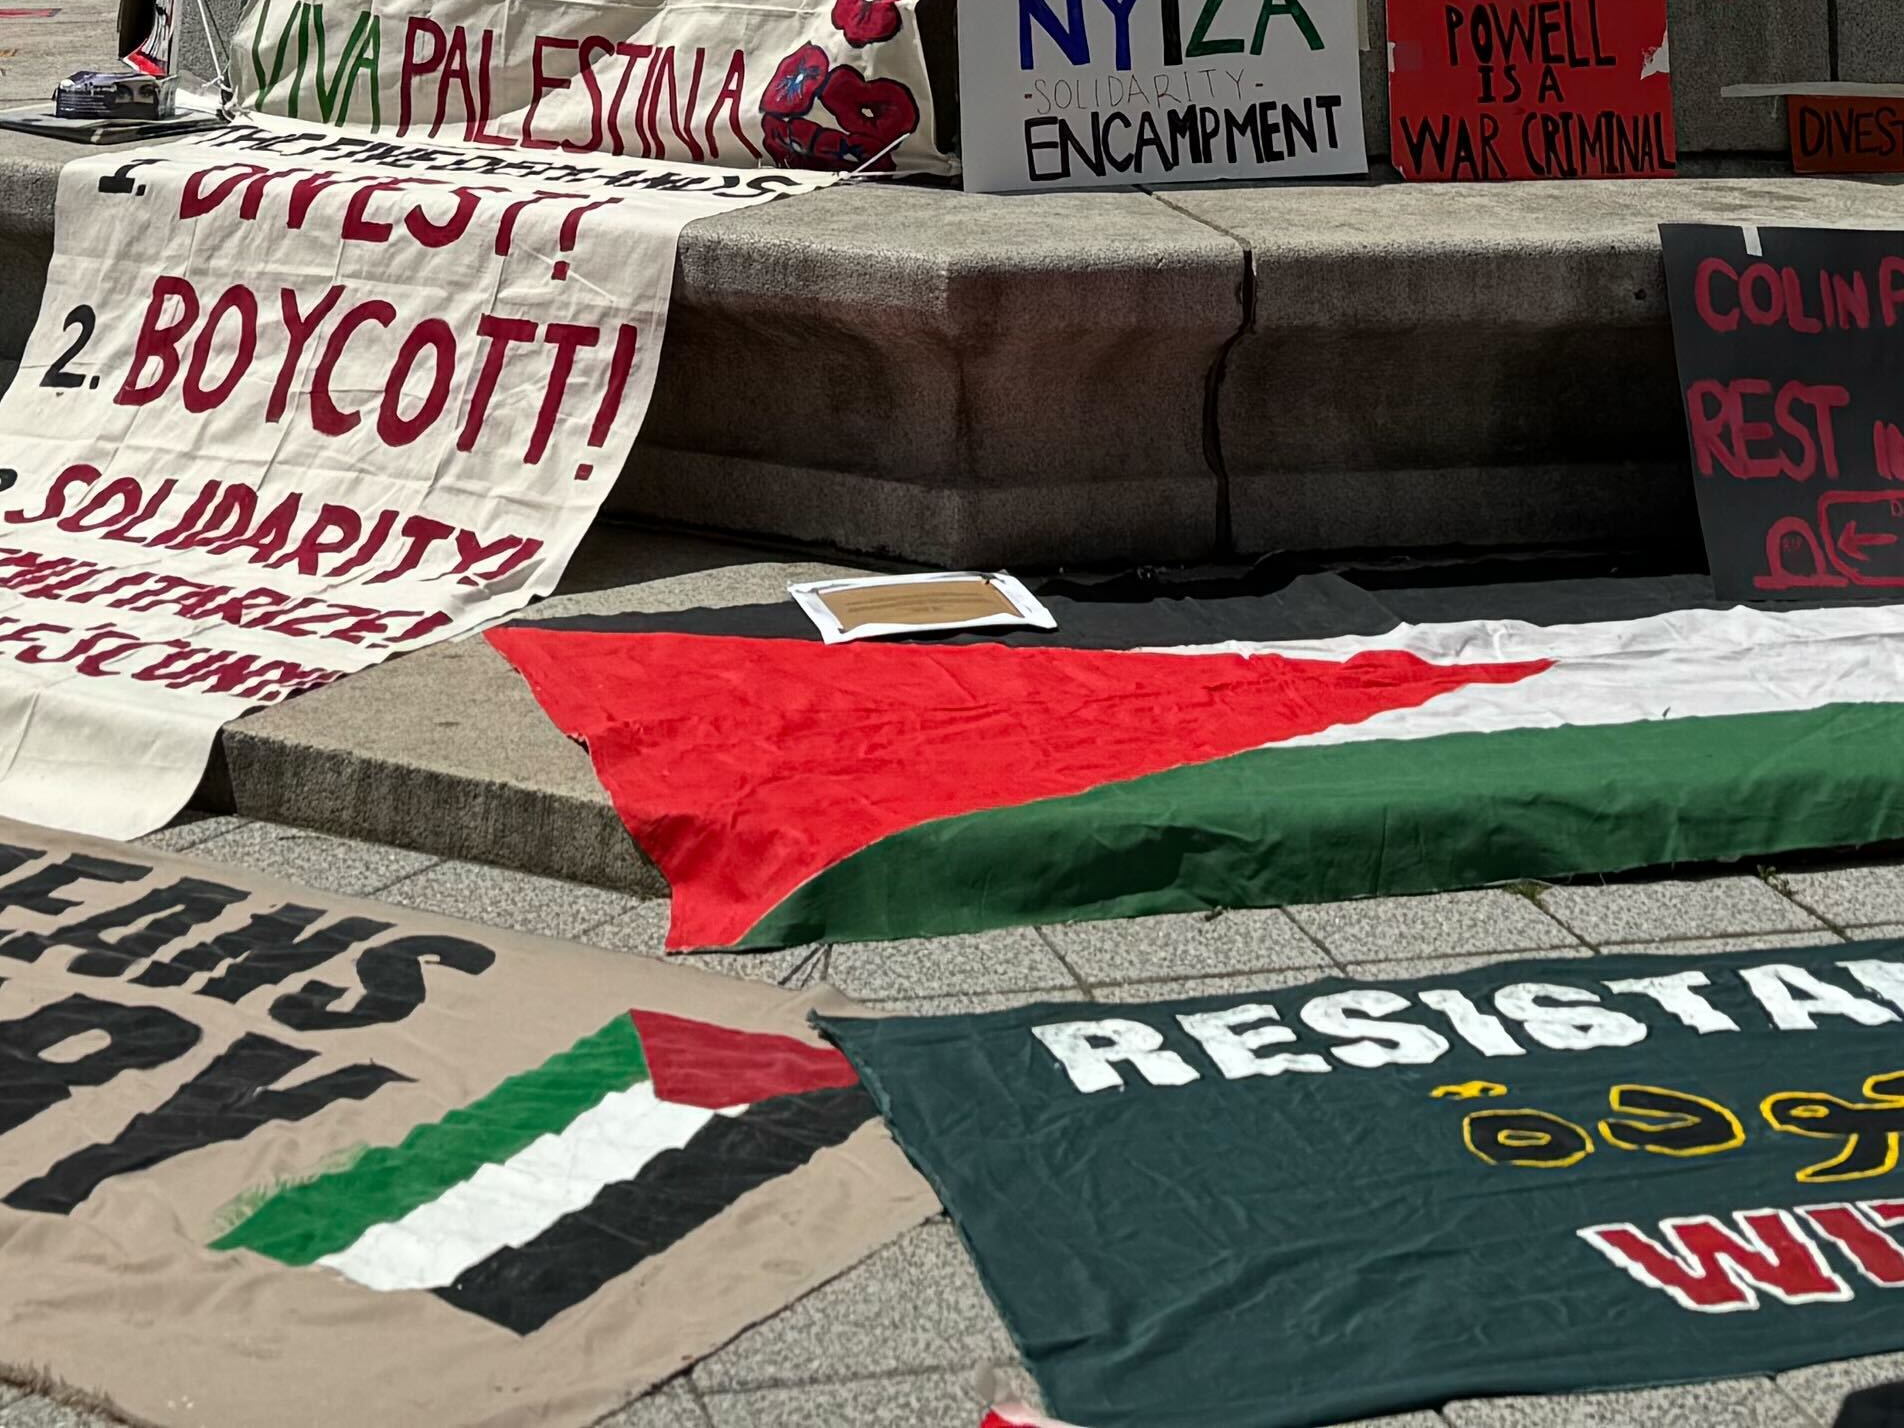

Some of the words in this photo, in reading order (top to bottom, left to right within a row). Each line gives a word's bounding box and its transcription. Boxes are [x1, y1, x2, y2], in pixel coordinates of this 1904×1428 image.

[398, 16, 764, 164] PALESTINA
[1477, 64, 1522, 104] IS
[1538, 65, 1564, 103] A
[422, 147, 812, 200] DEMANDS
[1024, 95, 1342, 182] ENCAMPMENT
[1400, 112, 1507, 182] WAR
[1520, 110, 1676, 178] CRIMINAL
[97, 158, 148, 199] 1.
[178, 162, 625, 281] DIVEST!
[1694, 256, 1870, 333] COLIN
[38, 303, 102, 392] 2.
[114, 273, 639, 482] BOYCOTT!
[1686, 378, 1850, 481] REST
[3, 462, 545, 588] SOLIDARITY!
